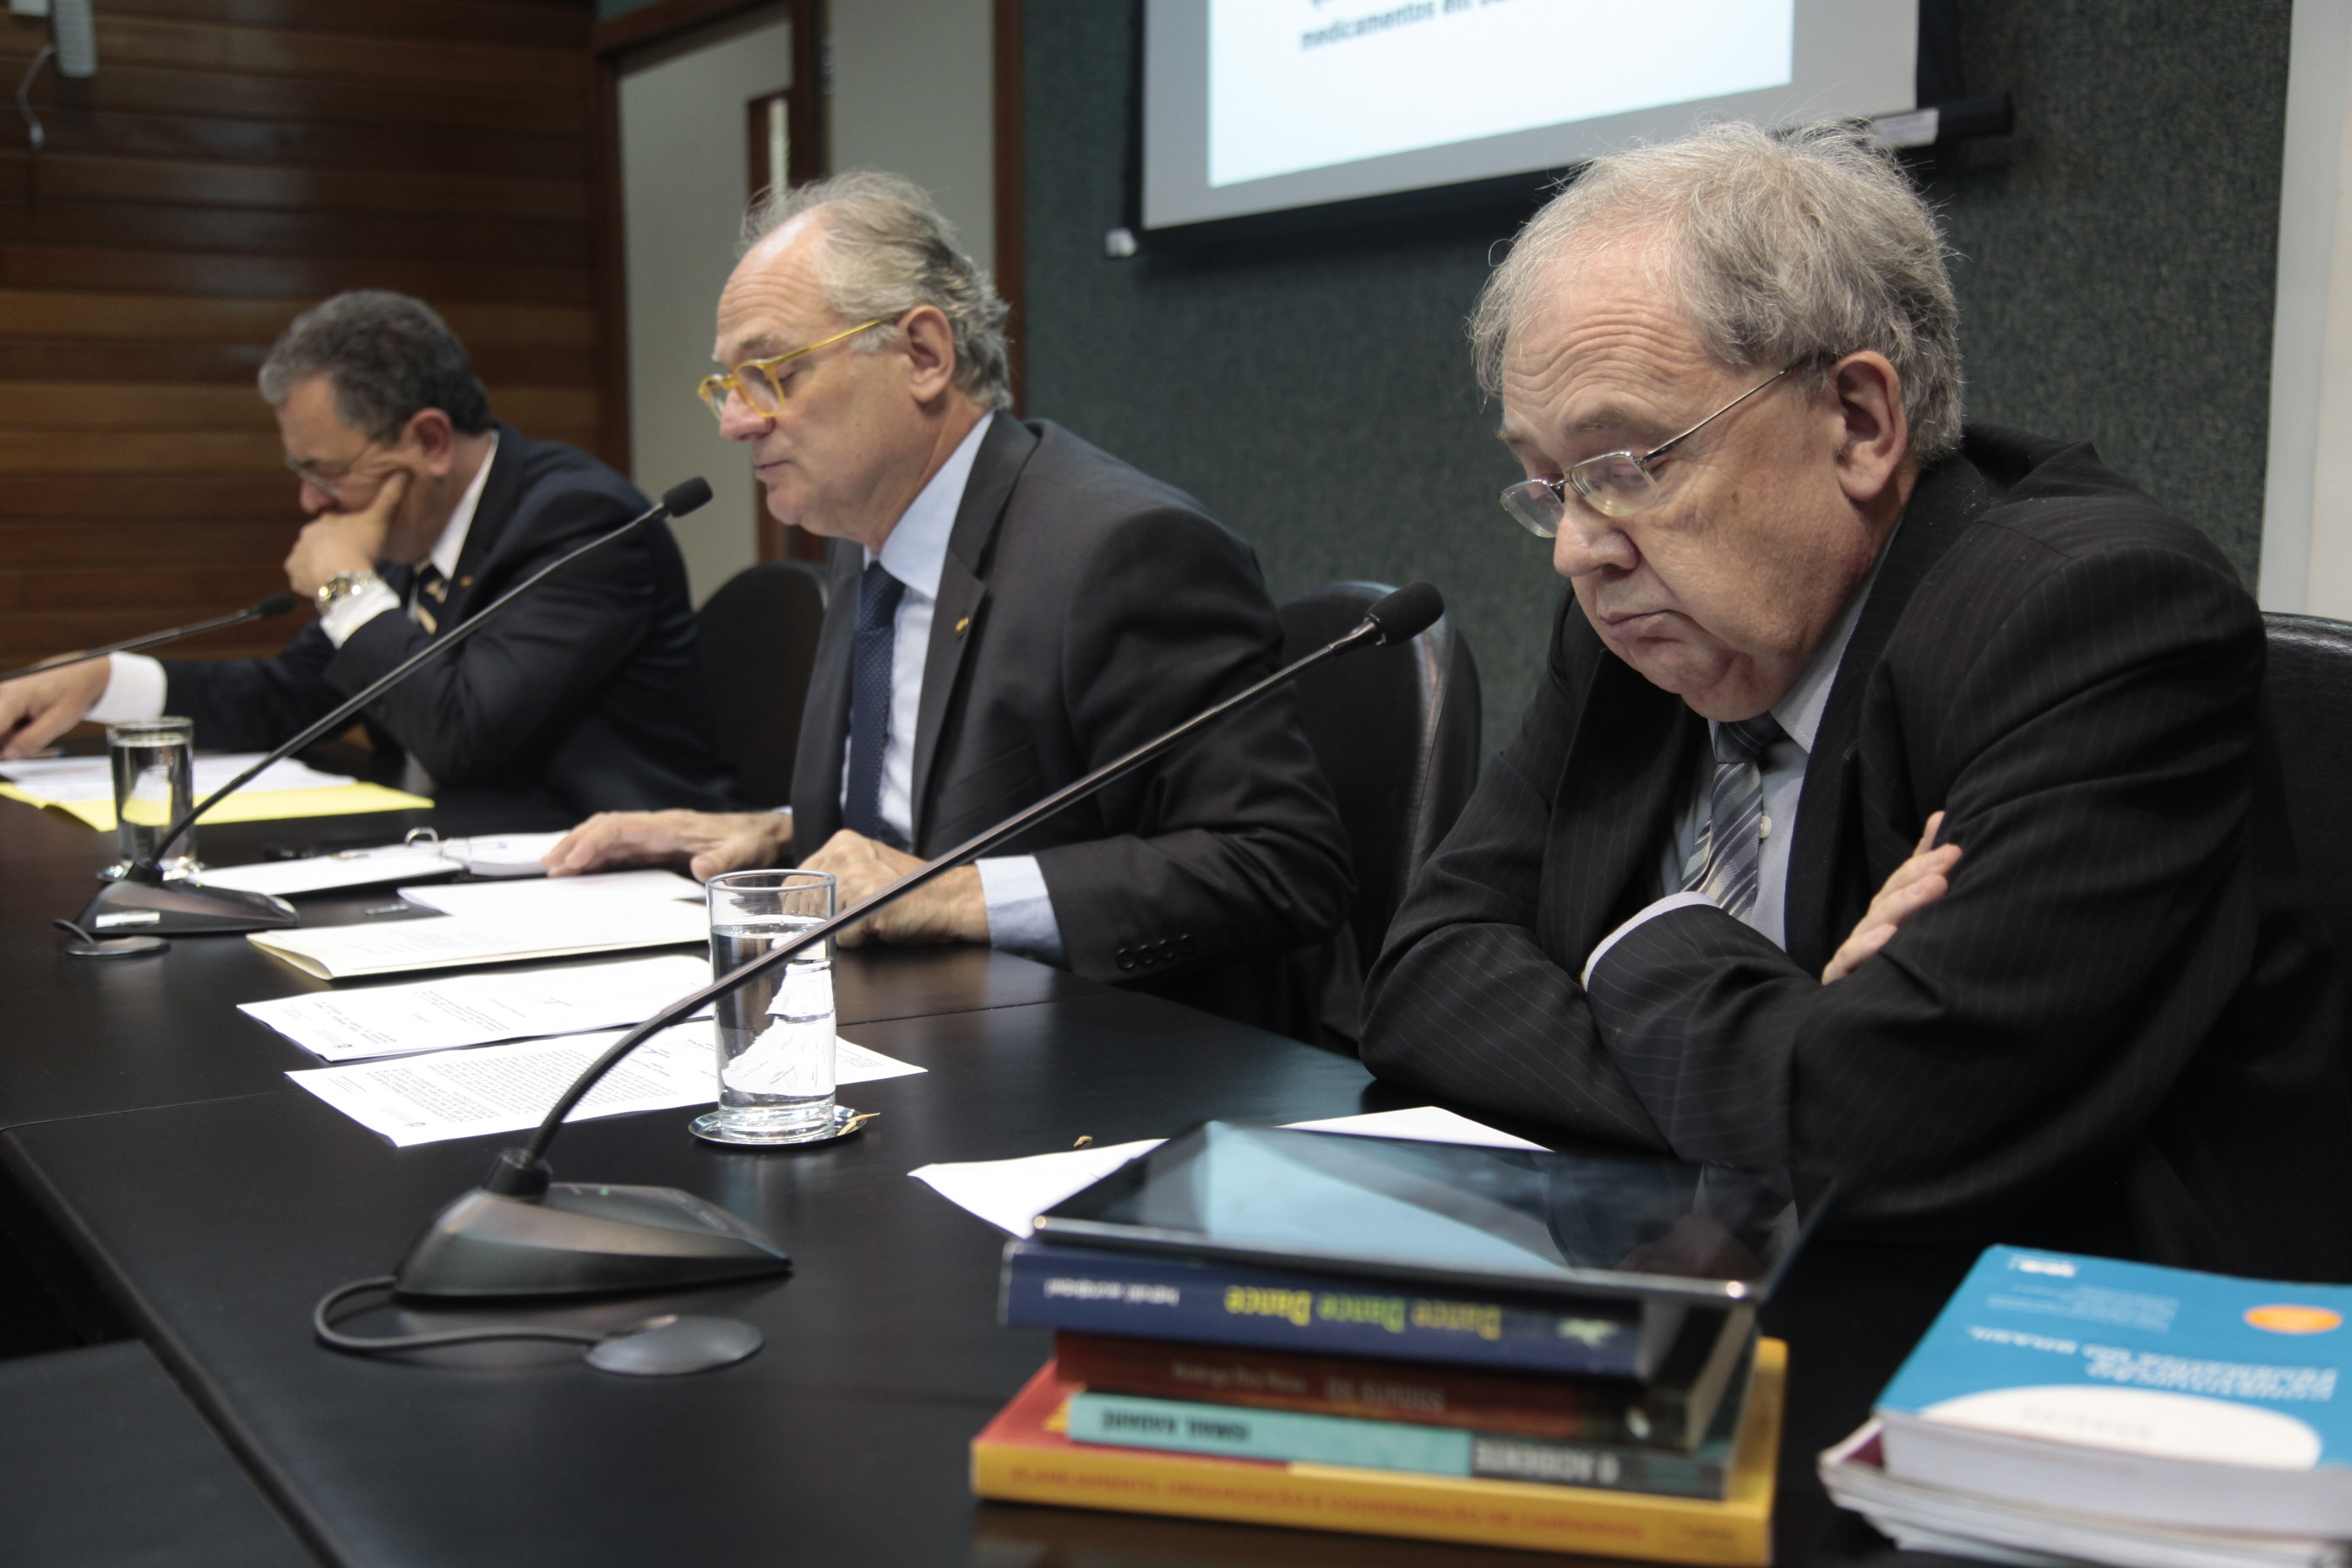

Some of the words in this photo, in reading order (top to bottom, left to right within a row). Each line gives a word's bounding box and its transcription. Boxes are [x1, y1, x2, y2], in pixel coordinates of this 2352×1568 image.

[1301, 3, 1435, 51] medicamentos
[1225, 1287, 1313, 1327] Dance
[1317, 1293, 1406, 1333] Dance
[1409, 1298, 1503, 1341] Dance
